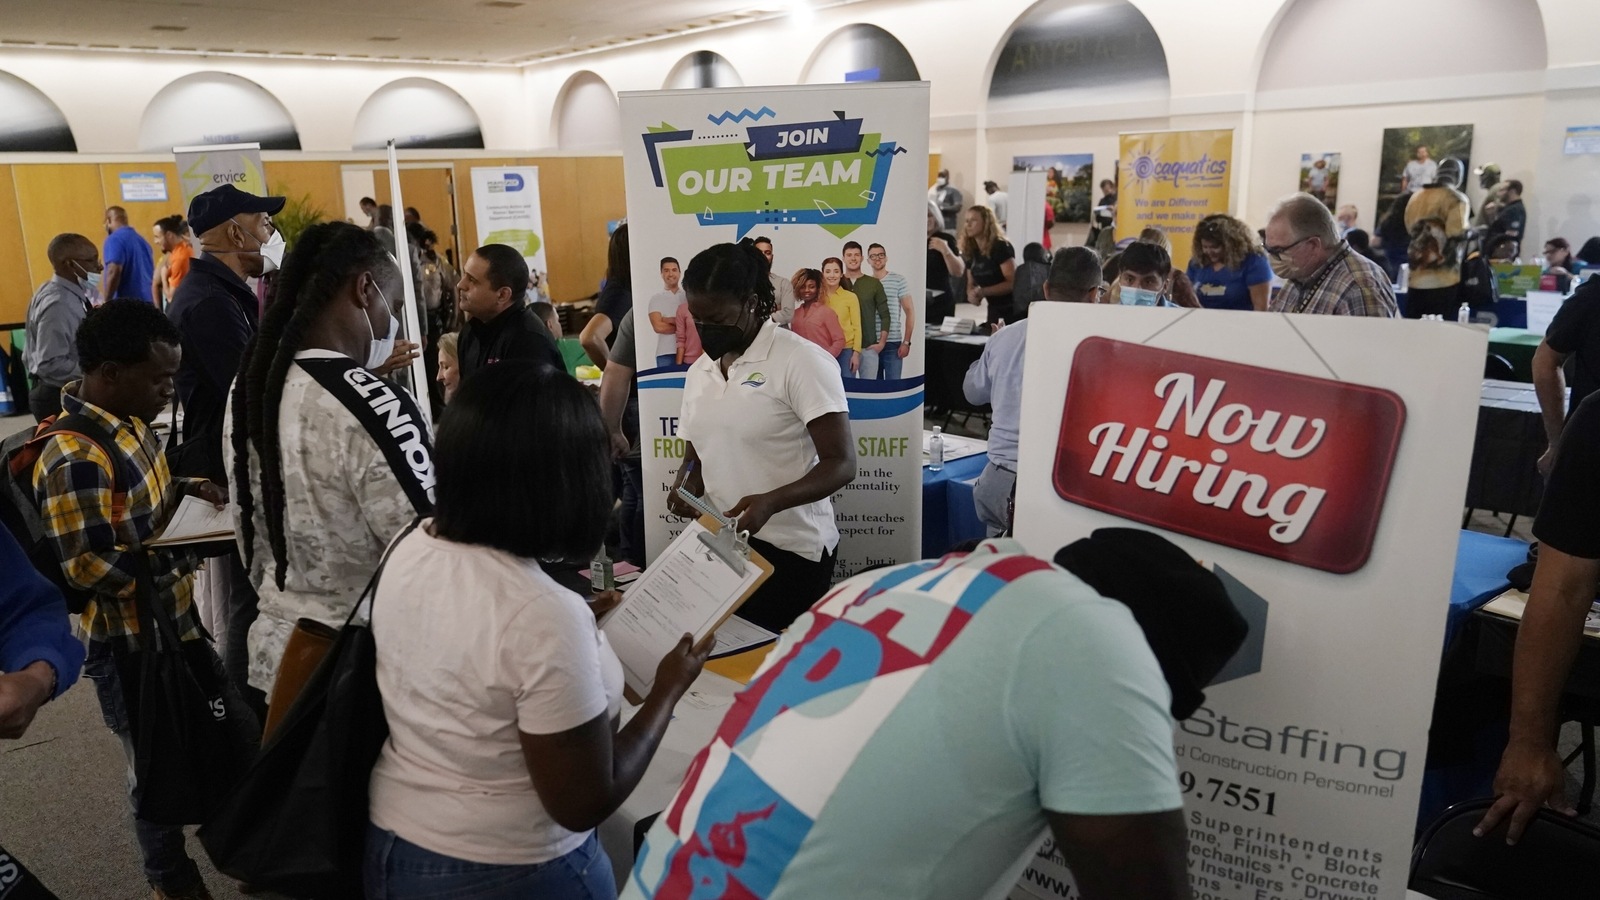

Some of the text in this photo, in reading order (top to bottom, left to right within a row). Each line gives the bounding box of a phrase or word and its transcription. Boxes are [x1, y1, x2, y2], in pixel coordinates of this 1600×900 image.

[776, 127, 829, 148] JOIN
[677, 159, 863, 196] OUR TEAM
[1135, 198, 1209, 207] We are Different
[1136, 211, 1153, 220] and
[1156, 212, 1169, 220] we
[1171, 211, 1196, 219] make
[1153, 372, 1327, 460] Now
[858, 437, 909, 457] STAFF
[845, 482, 900, 494] mentality
[859, 468, 892, 478] in the
[1088, 421, 1327, 545] Hiring
[836, 513, 858, 522] that
[862, 513, 905, 523] teaches
[838, 527, 874, 538] espect
[878, 526, 895, 536] for
[866, 556, 887, 565] but
[888, 557, 897, 565] it
[1180, 706, 1407, 780] Staffing
[1190, 746, 1298, 783] Construction
[1304, 771, 1394, 798] Personnel
[1180, 771, 1277, 817] 9.7551
[1191, 811, 1383, 863] Superintendents
[1188, 841, 1378, 895] echanics Concrete
[1202, 859, 1284, 892] Installers
[1234, 840, 1291, 864] Finish
[1325, 857, 1380, 880] Block
